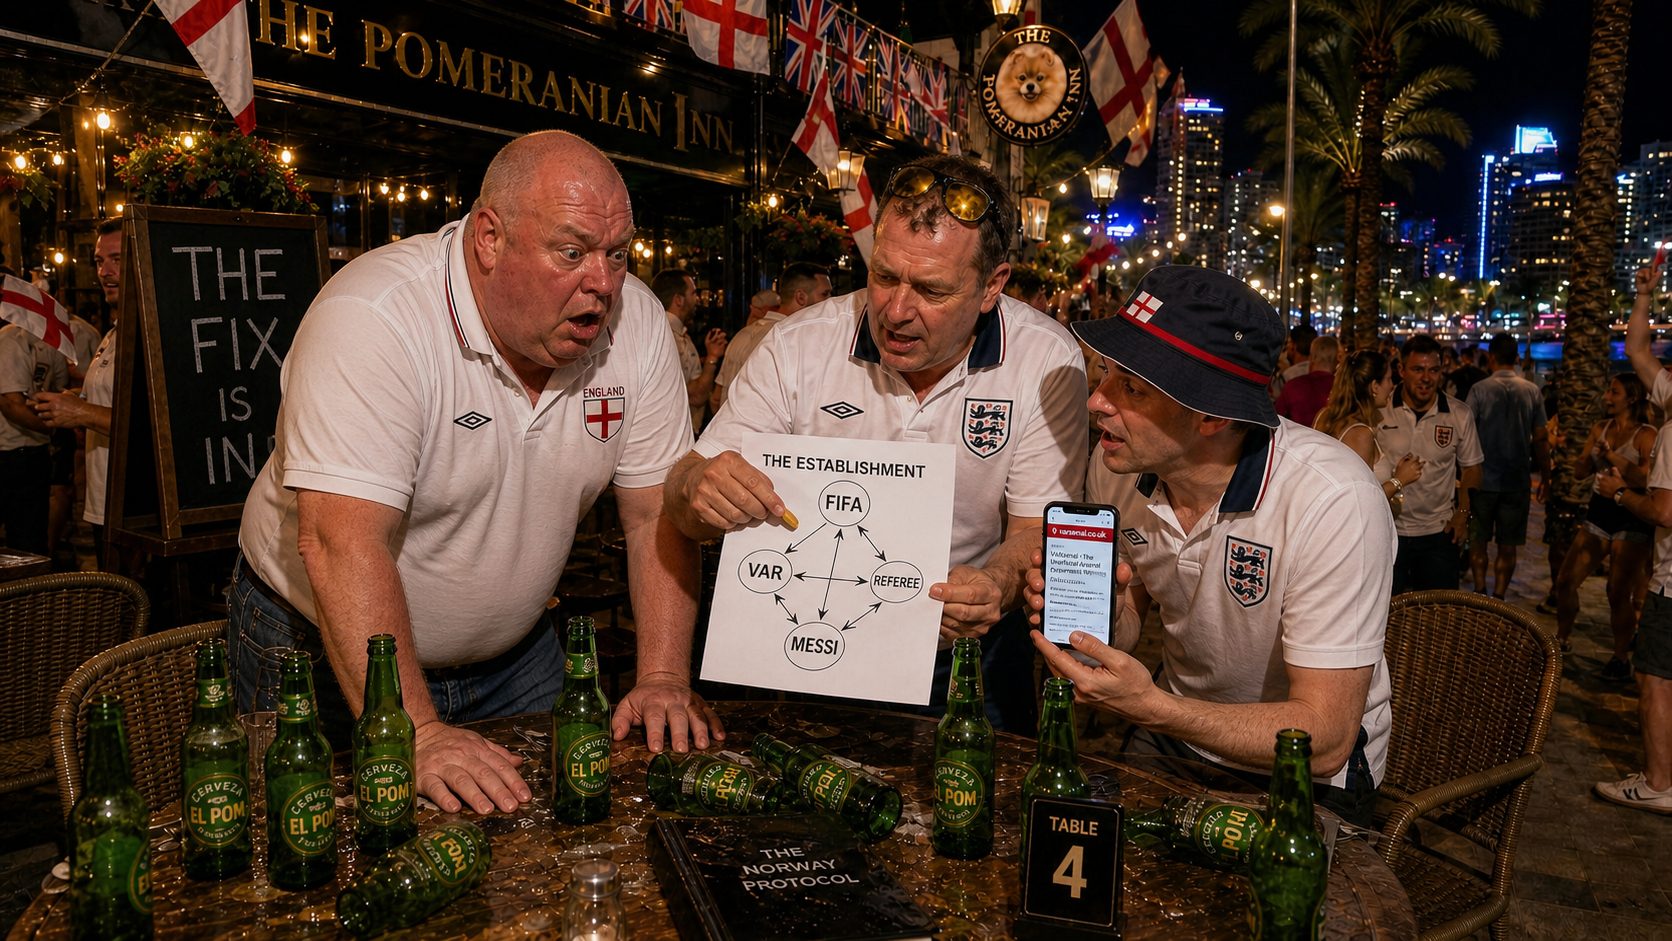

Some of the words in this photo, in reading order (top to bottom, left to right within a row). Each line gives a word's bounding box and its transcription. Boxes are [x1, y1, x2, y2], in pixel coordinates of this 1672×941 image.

[1014, 28, 1051, 45] THE
[255, 0, 337, 60] HE
[360, 19, 662, 137] POMERANIAN
[671, 91, 734, 153] INN
[171, 245, 286, 301] THE
[191, 316, 282, 374] FIX
[583, 386, 625, 398] ENGLAND
[218, 385, 252, 423] IS
[205, 432, 276, 486] IN
[762, 453, 792, 469] THE
[796, 456, 926, 479] ESTABLISHMENT
[825, 494, 863, 513] FIFA
[748, 562, 783, 580] VAR
[873, 574, 921, 589] REFEREE
[791, 636, 839, 655] MESSI
[361, 763, 408, 782] CERVEZA
[571, 762, 587, 778] EL
[191, 781, 243, 803] CERVEZA
[360, 784, 374, 803] EL
[377, 782, 409, 803] POM
[945, 788, 977, 807] POM
[190, 806, 207, 825] EL
[210, 800, 245, 825] POM
[289, 817, 309, 835] EL
[1049, 816, 1099, 837] TABLE
[760, 847, 805, 860] THE
[742, 858, 836, 876] NORWAY
[1052, 844, 1088, 899] 4
[741, 873, 860, 891] PROTOCOL
